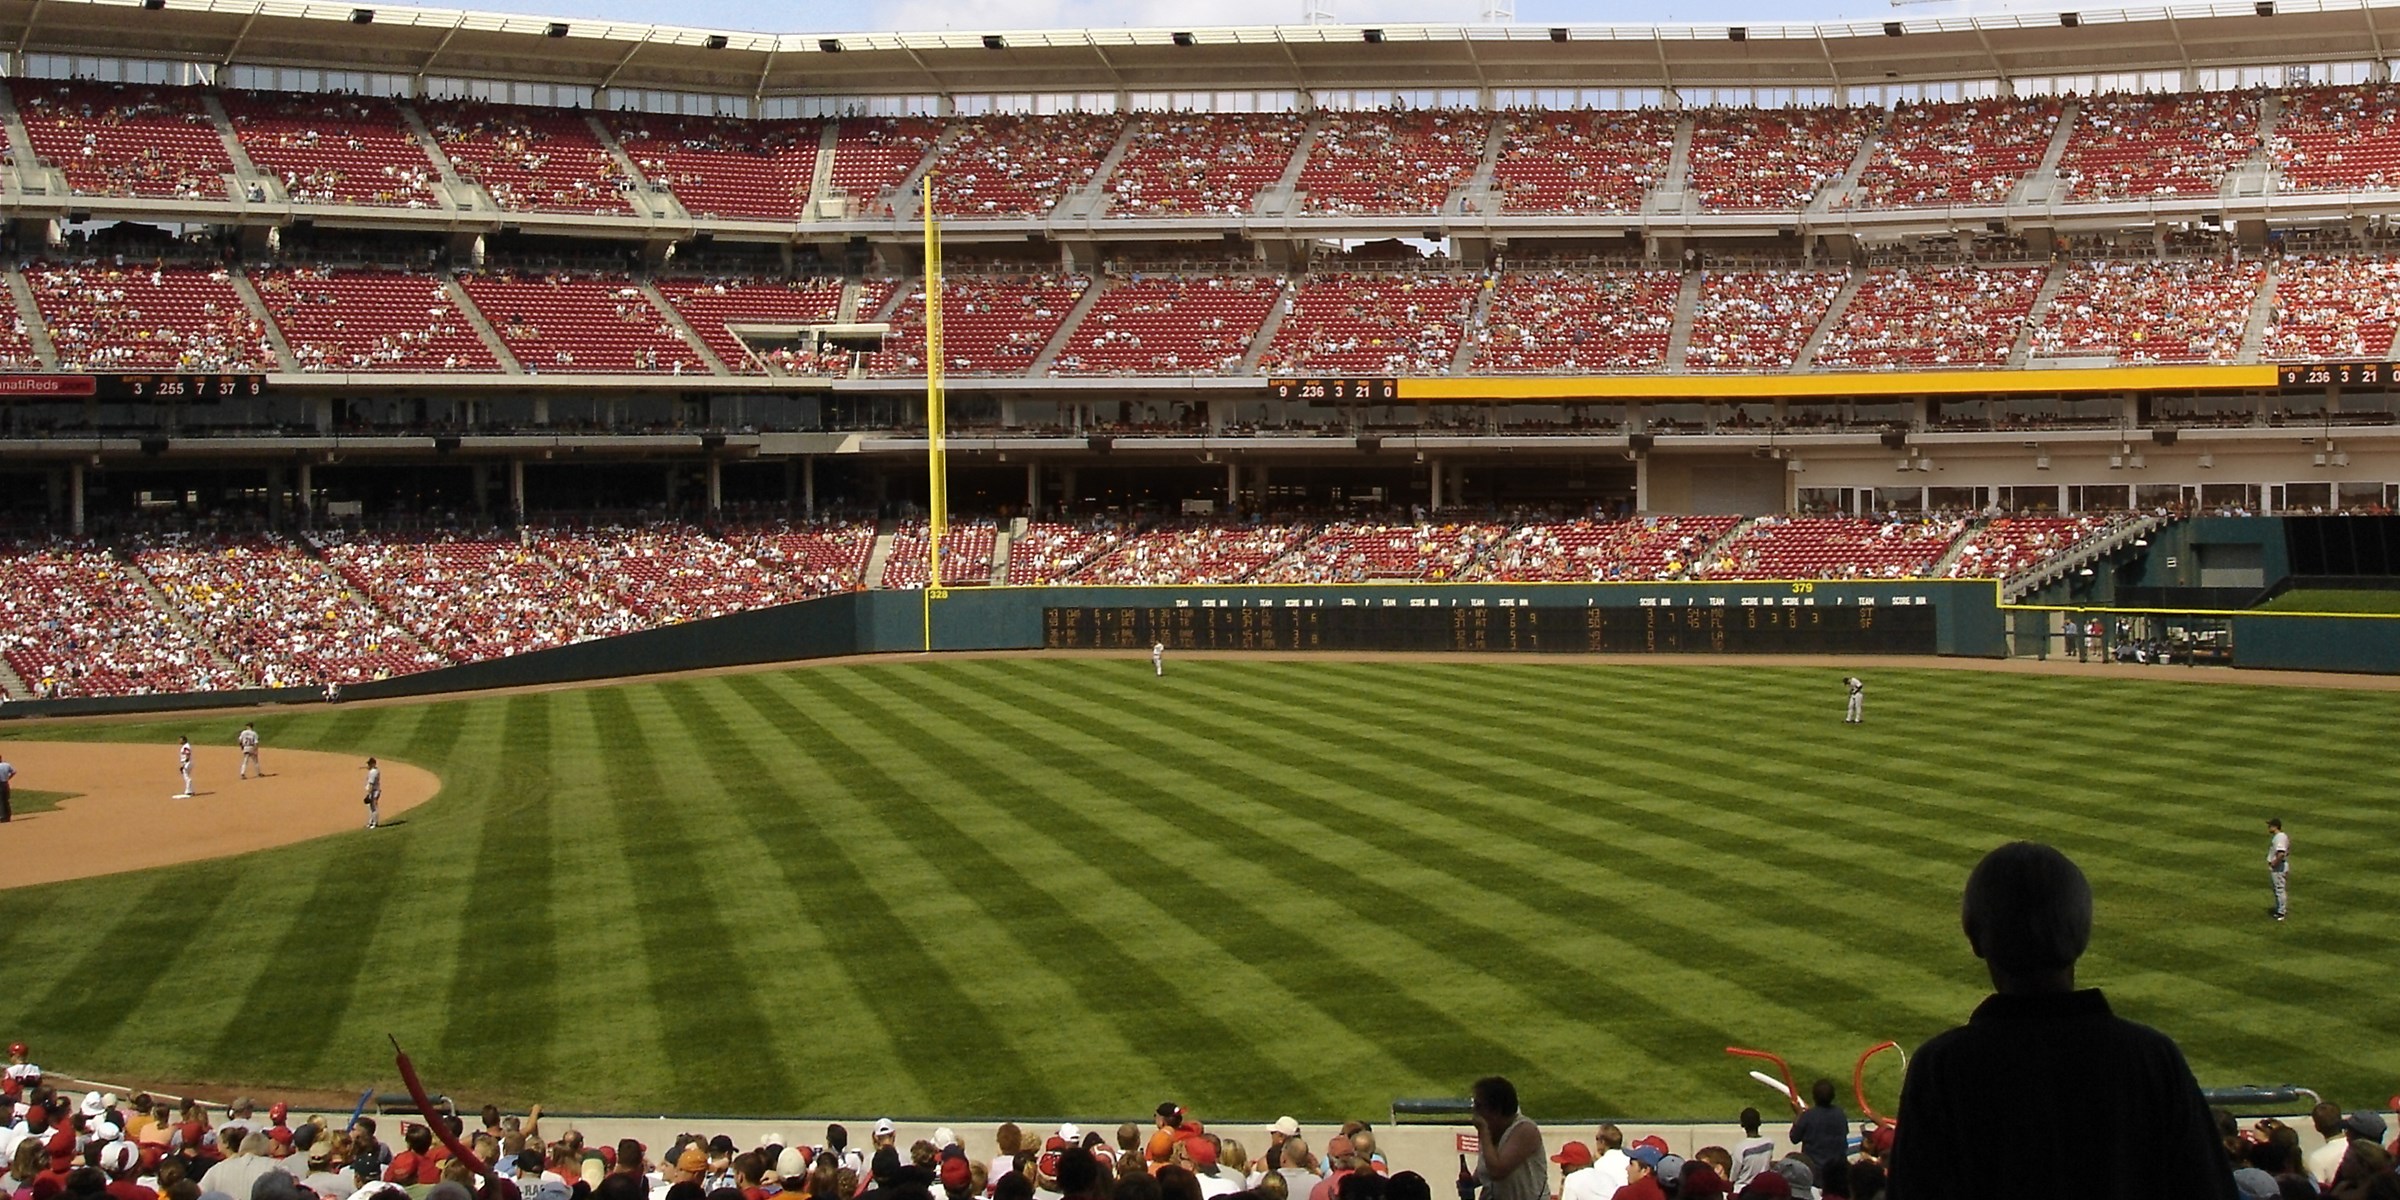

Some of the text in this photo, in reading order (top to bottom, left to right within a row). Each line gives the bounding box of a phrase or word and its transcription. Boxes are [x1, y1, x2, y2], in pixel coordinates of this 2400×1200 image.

[2288, 371, 2400, 383] 9 .236 3 21 0
[134, 383, 259, 395] 3 .255 7 37 9
[1279, 386, 1392, 397] 9 .236 3 21 0
[1792, 583, 1813, 593] 379
[930, 590, 948, 599] 328
